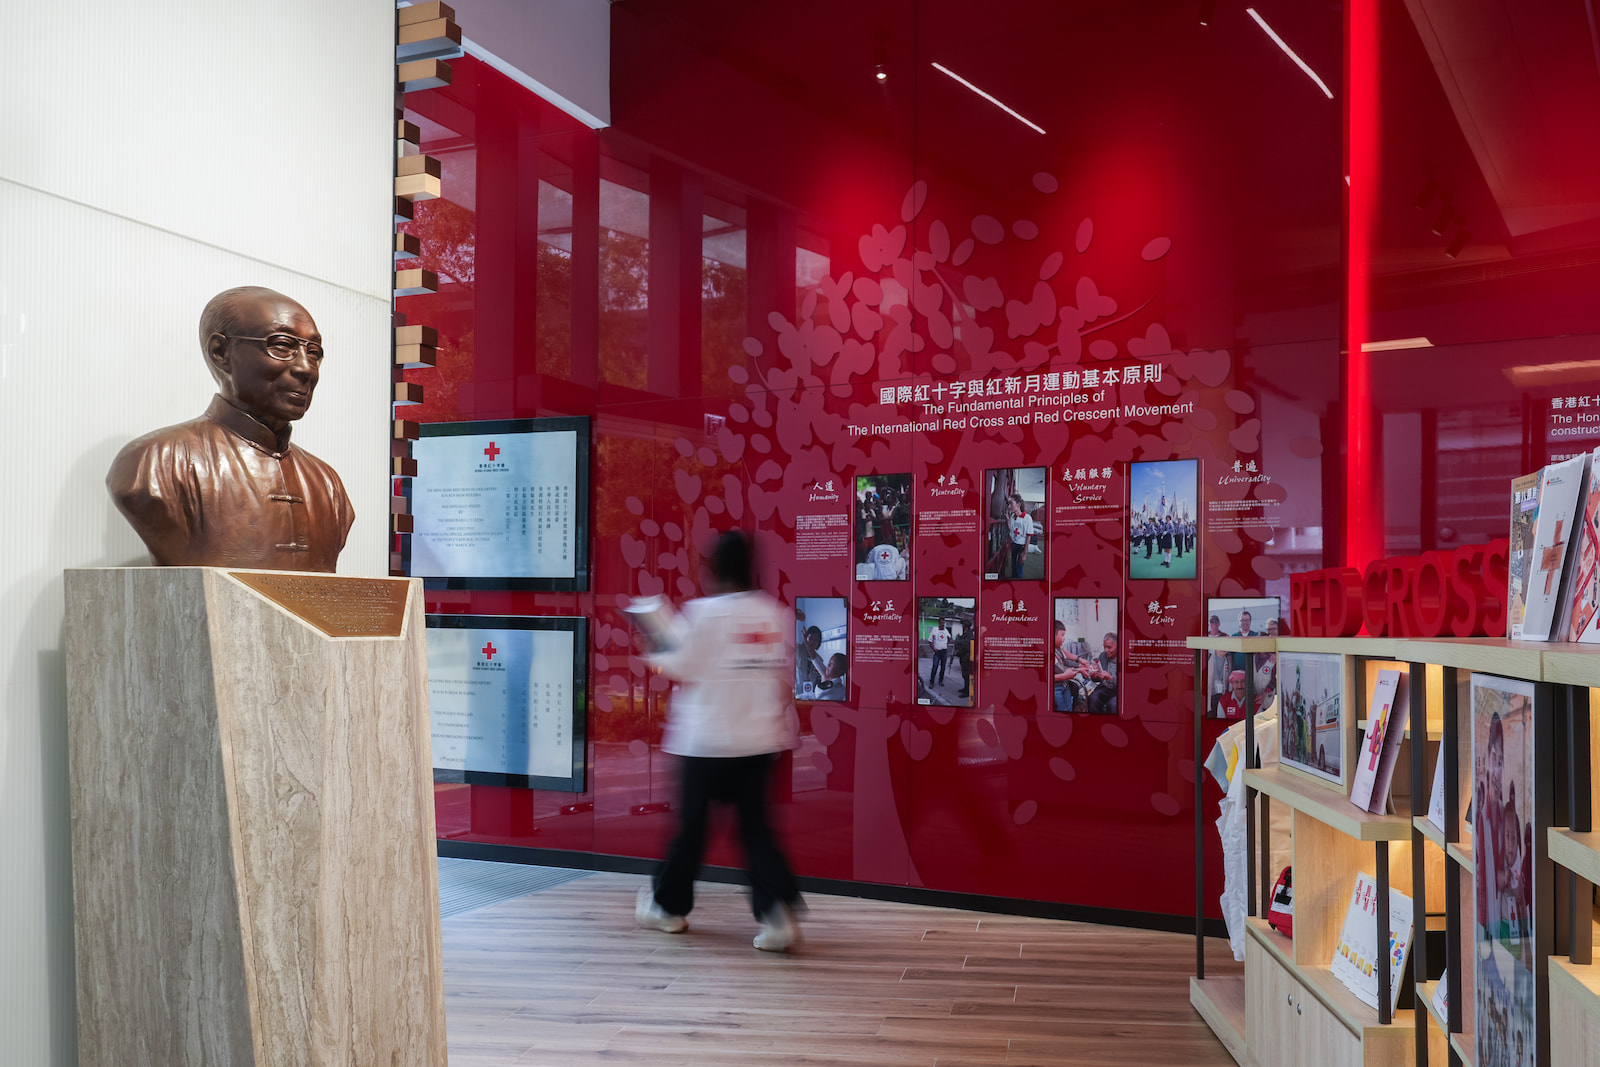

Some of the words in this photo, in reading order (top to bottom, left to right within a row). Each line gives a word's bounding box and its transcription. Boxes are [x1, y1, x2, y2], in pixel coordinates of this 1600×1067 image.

[880, 363, 1162, 406] 國際紅十字與紅新月運動基本原則
[922, 403, 945, 415] The
[948, 398, 1024, 413] Fundamental
[1028, 391, 1089, 408] Principles
[1092, 389, 1106, 402] of
[1551, 394, 1600, 410] 香港紅十
[847, 424, 868, 436] The
[871, 419, 940, 434] International
[943, 417, 967, 430] Red
[969, 415, 1005, 428] Cross
[1007, 412, 1031, 426] and
[1034, 410, 1060, 424] Red
[1062, 406, 1121, 422] Crescent
[1124, 401, 1194, 418] Movement
[1551, 414, 1573, 424] The
[1231, 459, 1259, 473] 普遍
[1062, 466, 1113, 481] 志願服務
[1218, 473, 1271, 486] Universality
[812, 479, 835, 492] 人道
[937, 474, 959, 487] 中立
[930, 487, 966, 498] Neutrality
[1068, 483, 1107, 493] Voluntary
[808, 493, 840, 503] Humanity
[1072, 494, 1102, 504] Service
[1290, 566, 1360, 638] RED
[1362, 539, 1509, 638] CROSS
[870, 600, 896, 612] 公正
[1002, 600, 1028, 613] 獨立
[1147, 600, 1178, 614] 統一
[863, 613, 902, 623] Impartiality
[991, 613, 1038, 624] Independence
[1150, 615, 1175, 627] Unity
